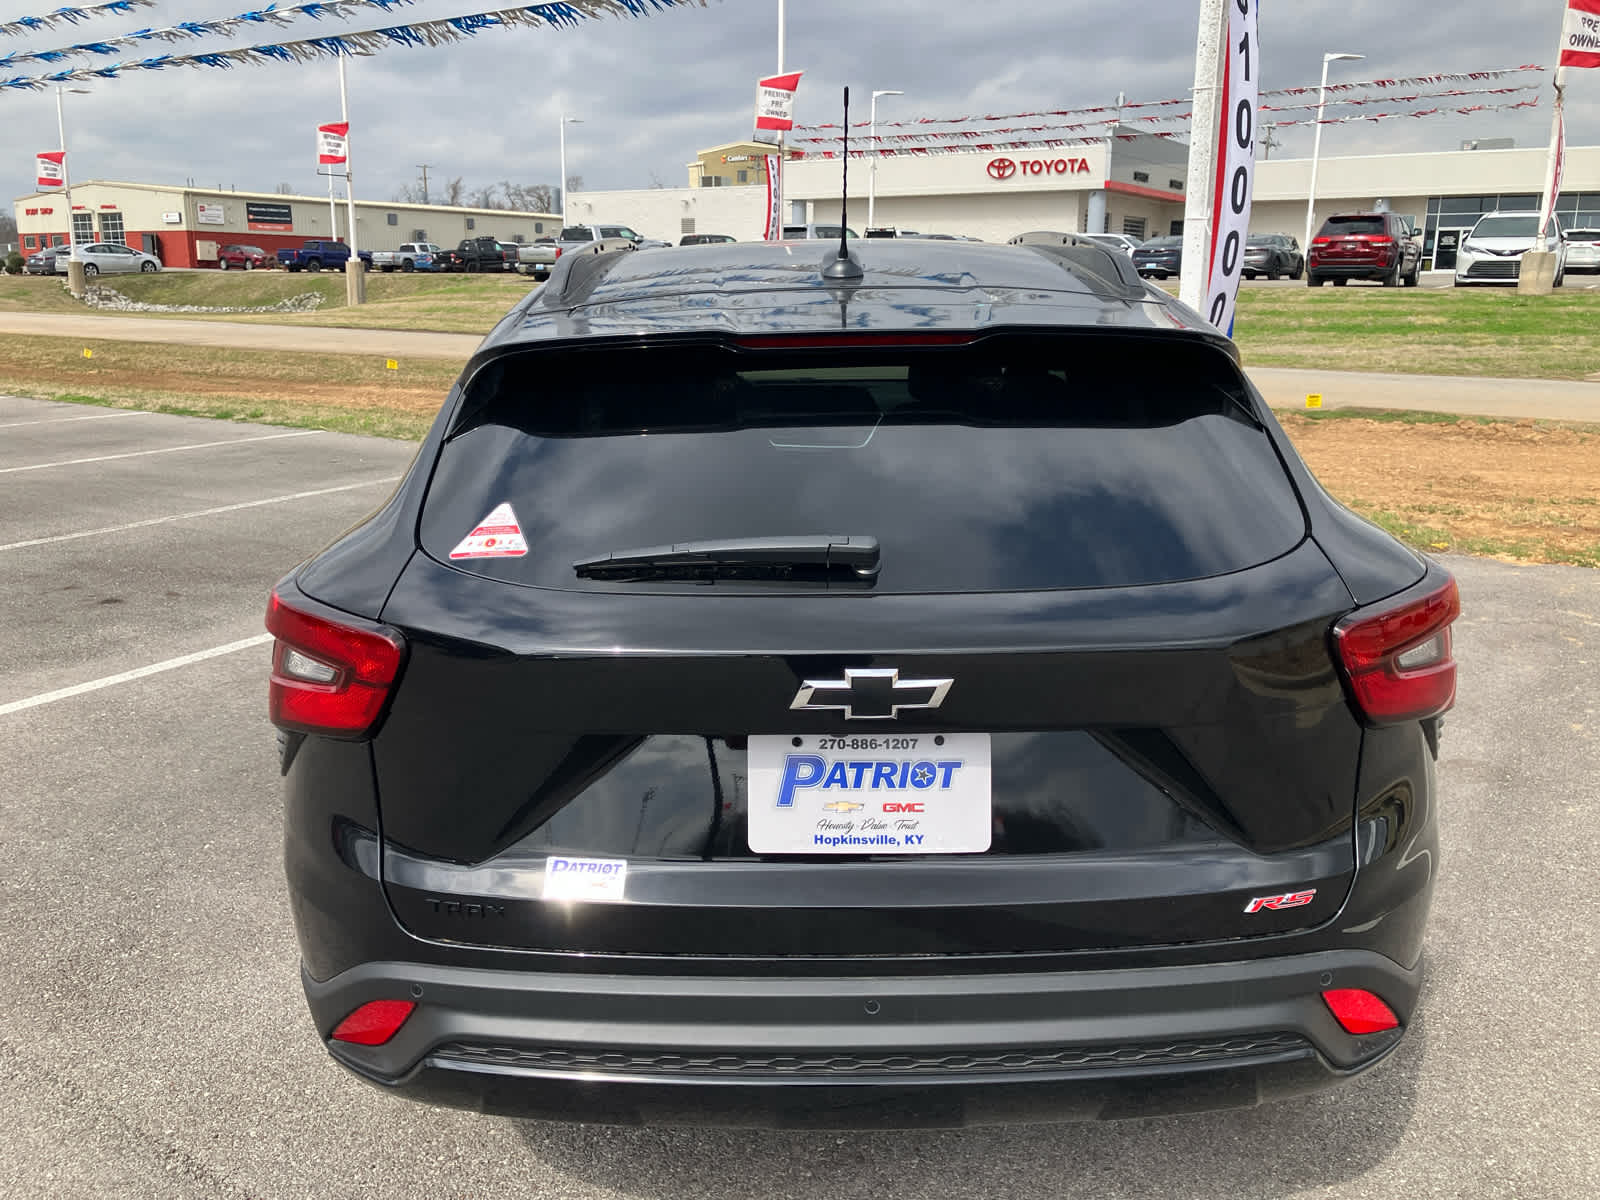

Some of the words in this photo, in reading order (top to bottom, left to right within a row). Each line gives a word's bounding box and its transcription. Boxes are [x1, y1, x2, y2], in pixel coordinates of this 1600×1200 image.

[1020, 158, 1090, 175] TOYOTA
[819, 738, 919, 750] 270-886-1207
[776, 754, 962, 808] PATRIOT
[882, 803, 925, 813] GMC
[816, 818, 855, 834] Honesty
[894, 819, 920, 831] Trust
[814, 834, 901, 847] Hopkinsville,
[904, 834, 925, 845] KY
[552, 859, 623, 875] PATRIOT
[1243, 888, 1317, 912] RS
